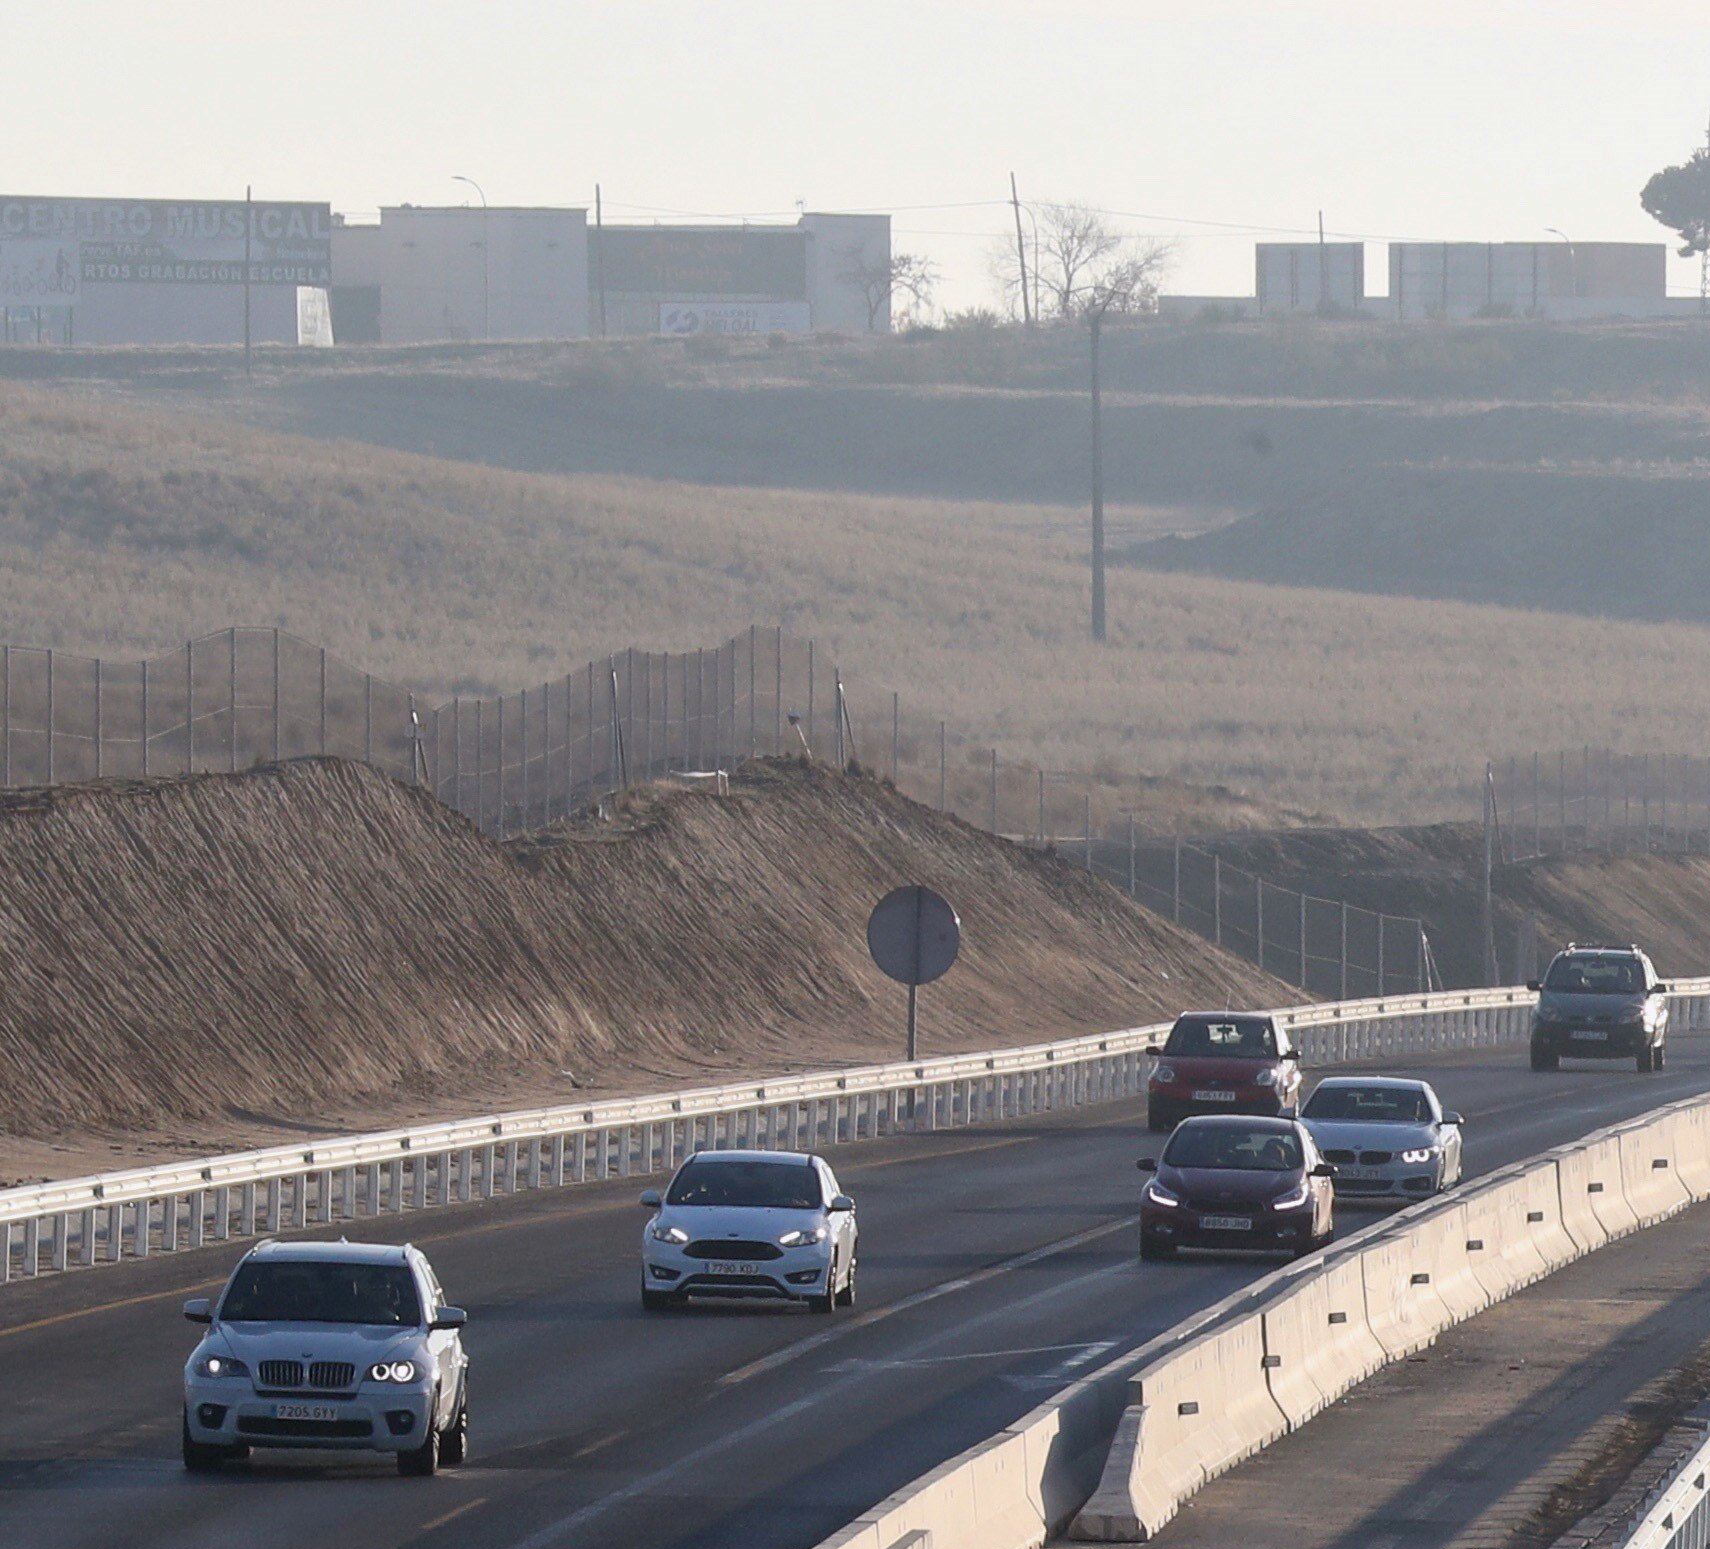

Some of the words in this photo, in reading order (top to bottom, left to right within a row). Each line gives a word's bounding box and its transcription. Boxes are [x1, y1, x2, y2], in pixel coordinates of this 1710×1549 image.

[2, 203, 152, 236] CENTRO
[167, 206, 330, 239] MUSICAL
[250, 265, 329, 282] ESCUELA
